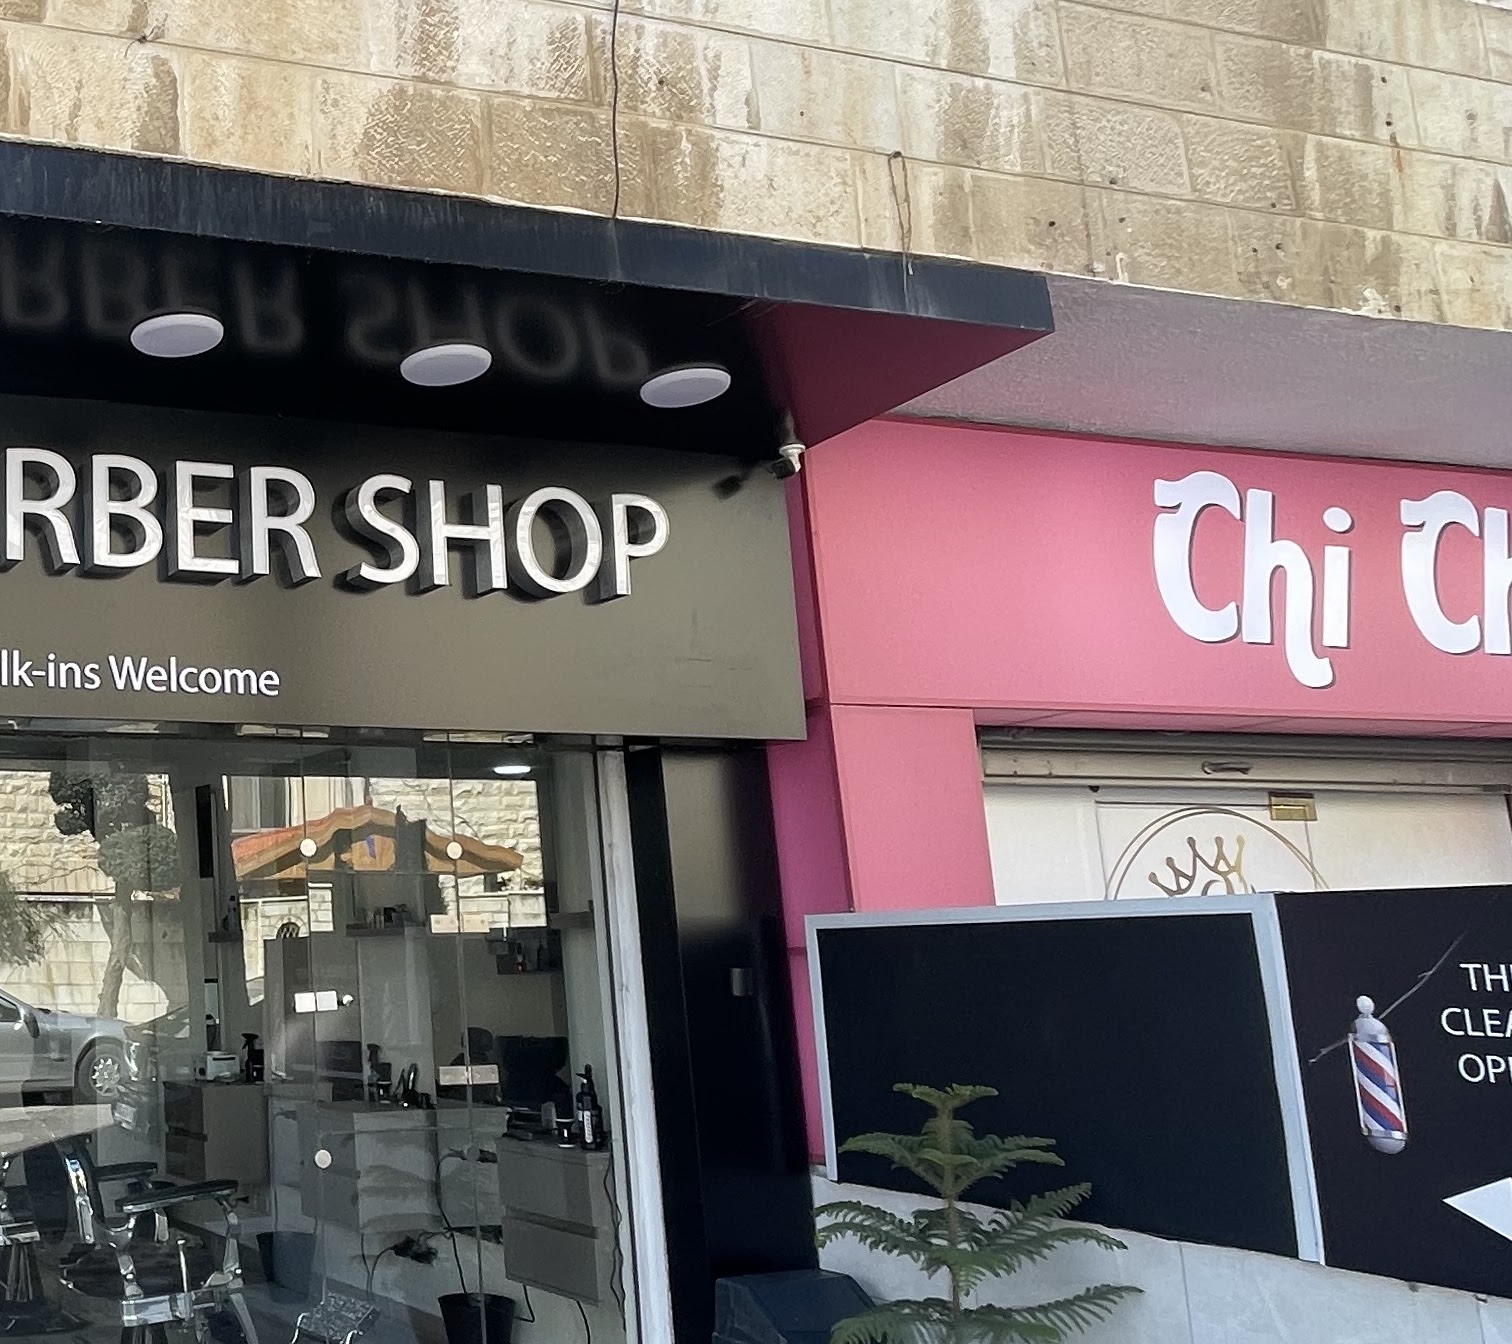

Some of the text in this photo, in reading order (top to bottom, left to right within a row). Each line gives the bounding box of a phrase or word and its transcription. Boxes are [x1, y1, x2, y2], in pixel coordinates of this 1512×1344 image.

[352, 473, 671, 597] SHOP
[1152, 470, 1353, 688] Chi
[108, 655, 280, 696] Welcome
[1459, 963, 1512, 992] TH
[1457, 1053, 1512, 1084] OP
